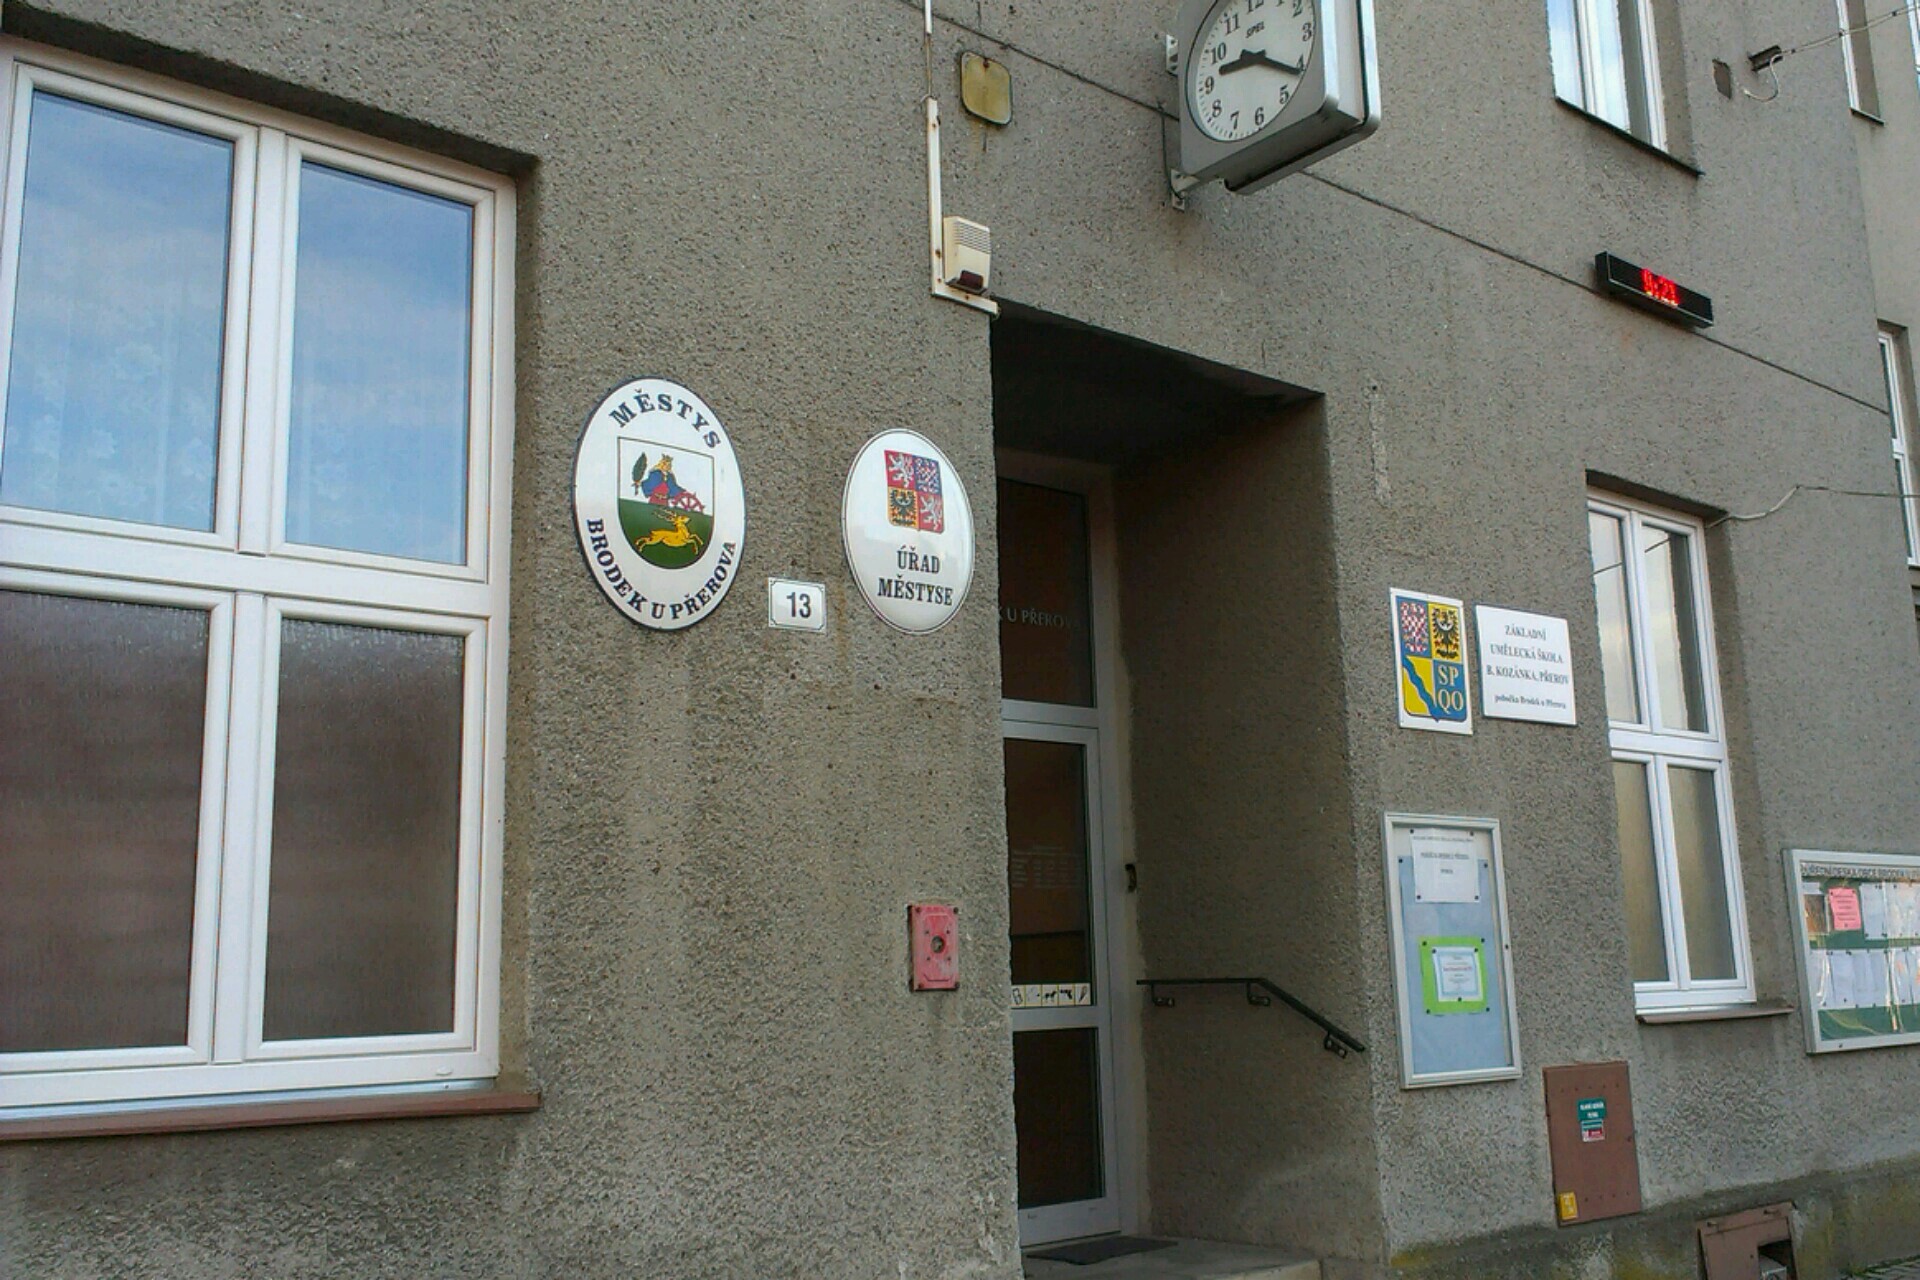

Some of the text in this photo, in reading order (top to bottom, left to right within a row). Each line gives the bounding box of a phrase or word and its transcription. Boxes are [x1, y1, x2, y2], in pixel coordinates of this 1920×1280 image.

[1292, 0, 1303, 17] 2
[1223, 14, 1241, 35] 11
[1302, 22, 1312, 42] 3
[1211, 42, 1227, 65] 10
[1204, 76, 1215, 95] 9
[1279, 84, 1290, 105] 5
[1211, 99, 1222, 118] 8
[1254, 107, 1265, 126] 6
[1230, 110, 1240, 131] 7
[608, 388, 721, 449] MĚSTYS
[586, 518, 736, 620] BRODEK U PŘEROVA
[896, 545, 941, 574] ÚŘAD
[877, 575, 953, 607] MĚSTYSE
[786, 592, 812, 619] 13
[1007, 607, 1017, 623] U
[1021, 608, 1080, 629] PŘEROV
[1504, 623, 1547, 641] ZÁKLADNÍ
[1490, 643, 1564, 664] UMĚLECKÁ ŠKOLA
[1438, 664, 1459, 687] SP
[1539, 670, 1569, 685] PŘEROV
[1438, 689, 1464, 714] QO
